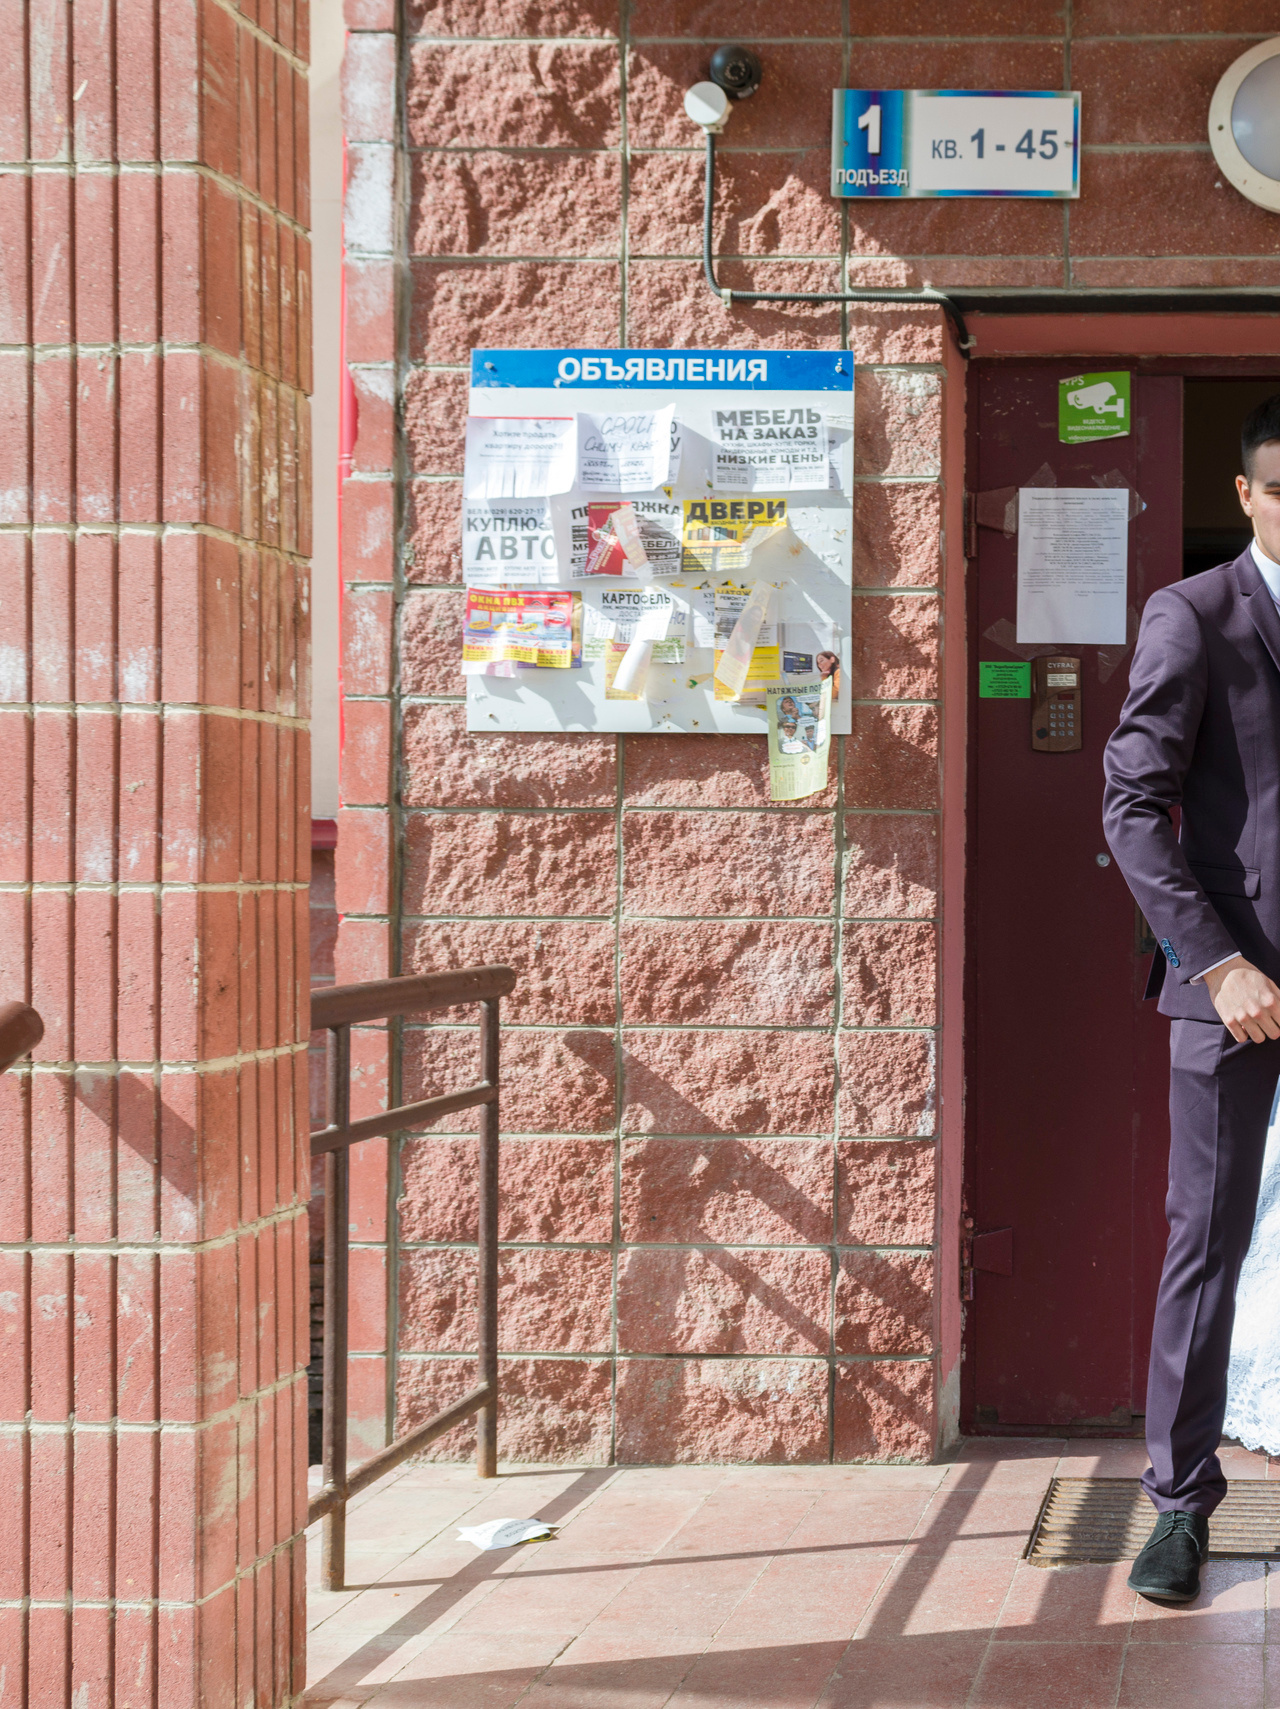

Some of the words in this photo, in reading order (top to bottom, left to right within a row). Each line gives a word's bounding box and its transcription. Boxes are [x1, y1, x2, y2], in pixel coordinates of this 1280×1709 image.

[858, 105, 881, 154] 1
[931, 139, 963, 159] КВ.
[836, 168, 909, 187] ПОДЪЕЗД
[557, 357, 768, 382] ОБЪЯВЛЕНИЯ
[716, 408, 822, 427] МЕБЕЛЬ
[493, 430, 521, 438] Хотите
[522, 431, 557, 439] продать
[720, 428, 749, 441] НА
[753, 426, 818, 440] ЗАКАЗ
[716, 454, 777, 465] НИЗКИЕ
[780, 453, 824, 465] ЦЕНЫ
[686, 501, 786, 524] ДВЕРИ
[467, 517, 538, 532] КУПЛЮ
[475, 534, 555, 561] АВТО
[720, 546, 742, 554] ДВЕР
[469, 594, 501, 606] ОКНА
[503, 597, 525, 606] ПВХ
[602, 592, 671, 605] КАРТОФЕЛЬ
[766, 685, 808, 695] НАТЯЖНЫЕ
